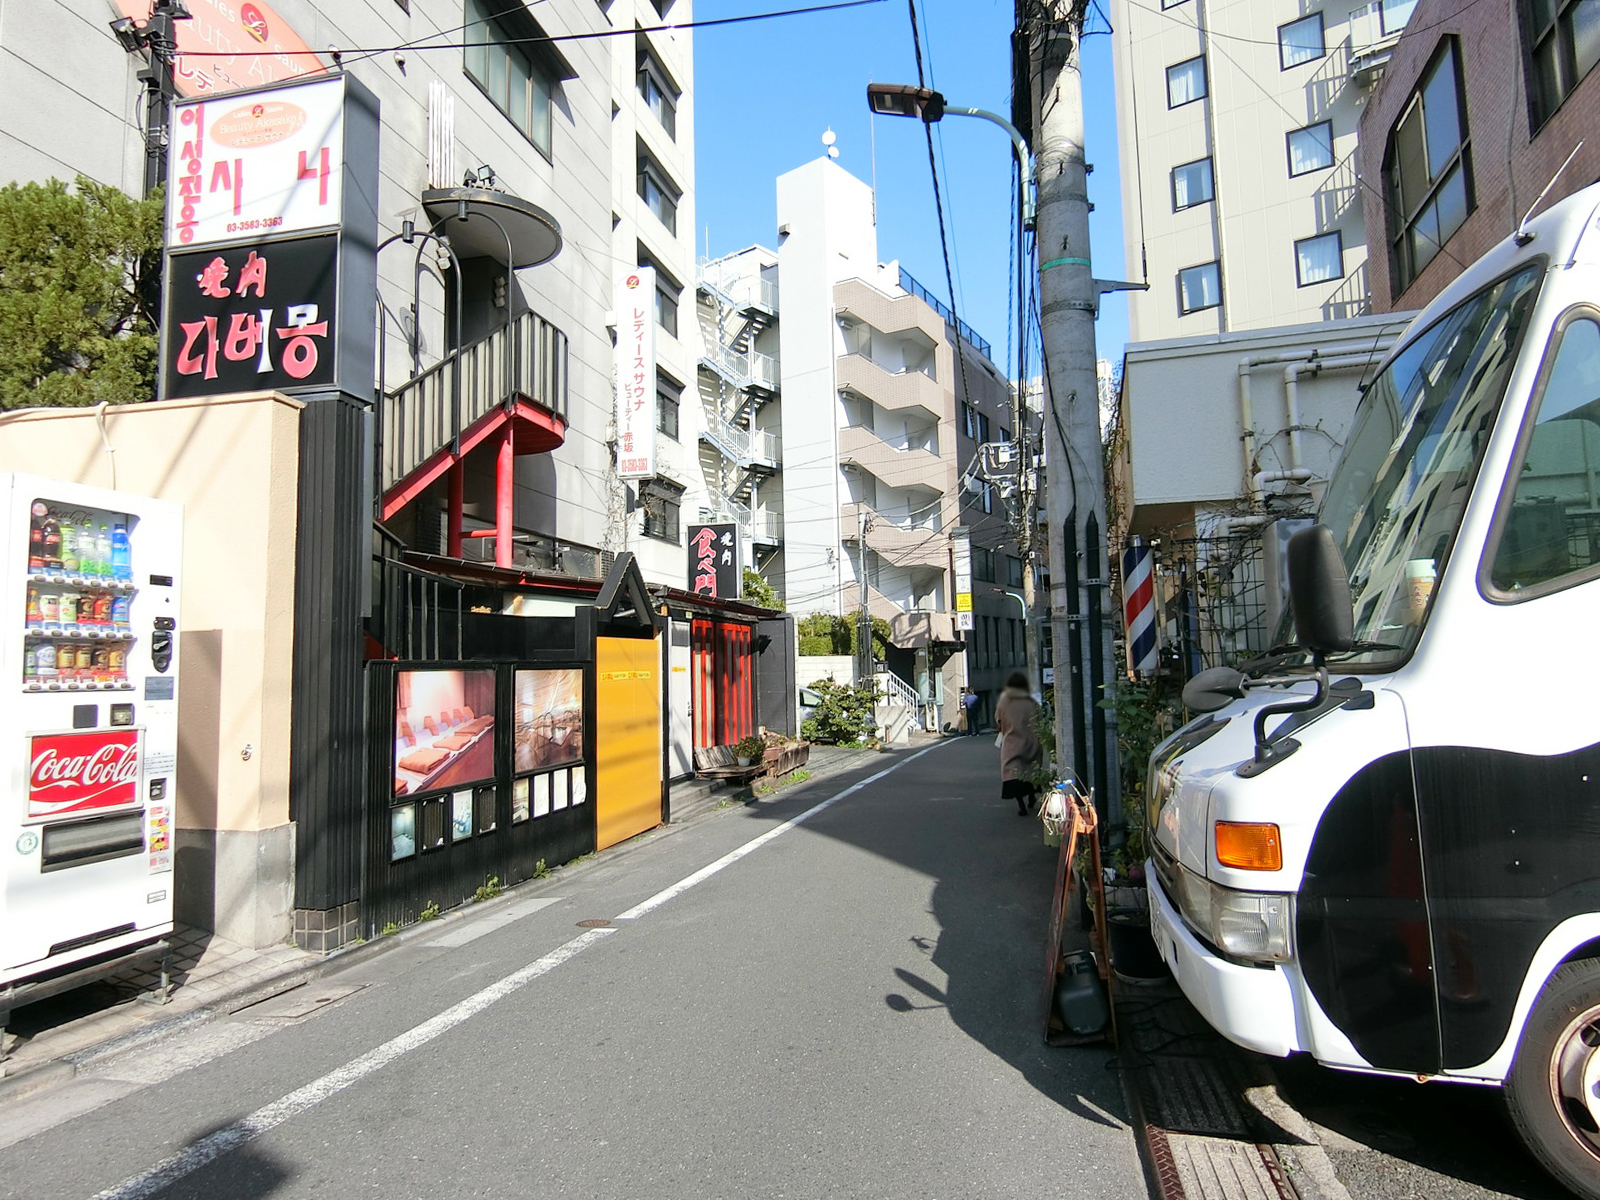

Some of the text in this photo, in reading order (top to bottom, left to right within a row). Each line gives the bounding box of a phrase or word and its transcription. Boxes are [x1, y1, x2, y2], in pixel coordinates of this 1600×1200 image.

[226, 216, 283, 233] 03-3583-3363
[690, 528, 718, 598] 食べ門
[31, 742, 138, 786] Coca-Cola
